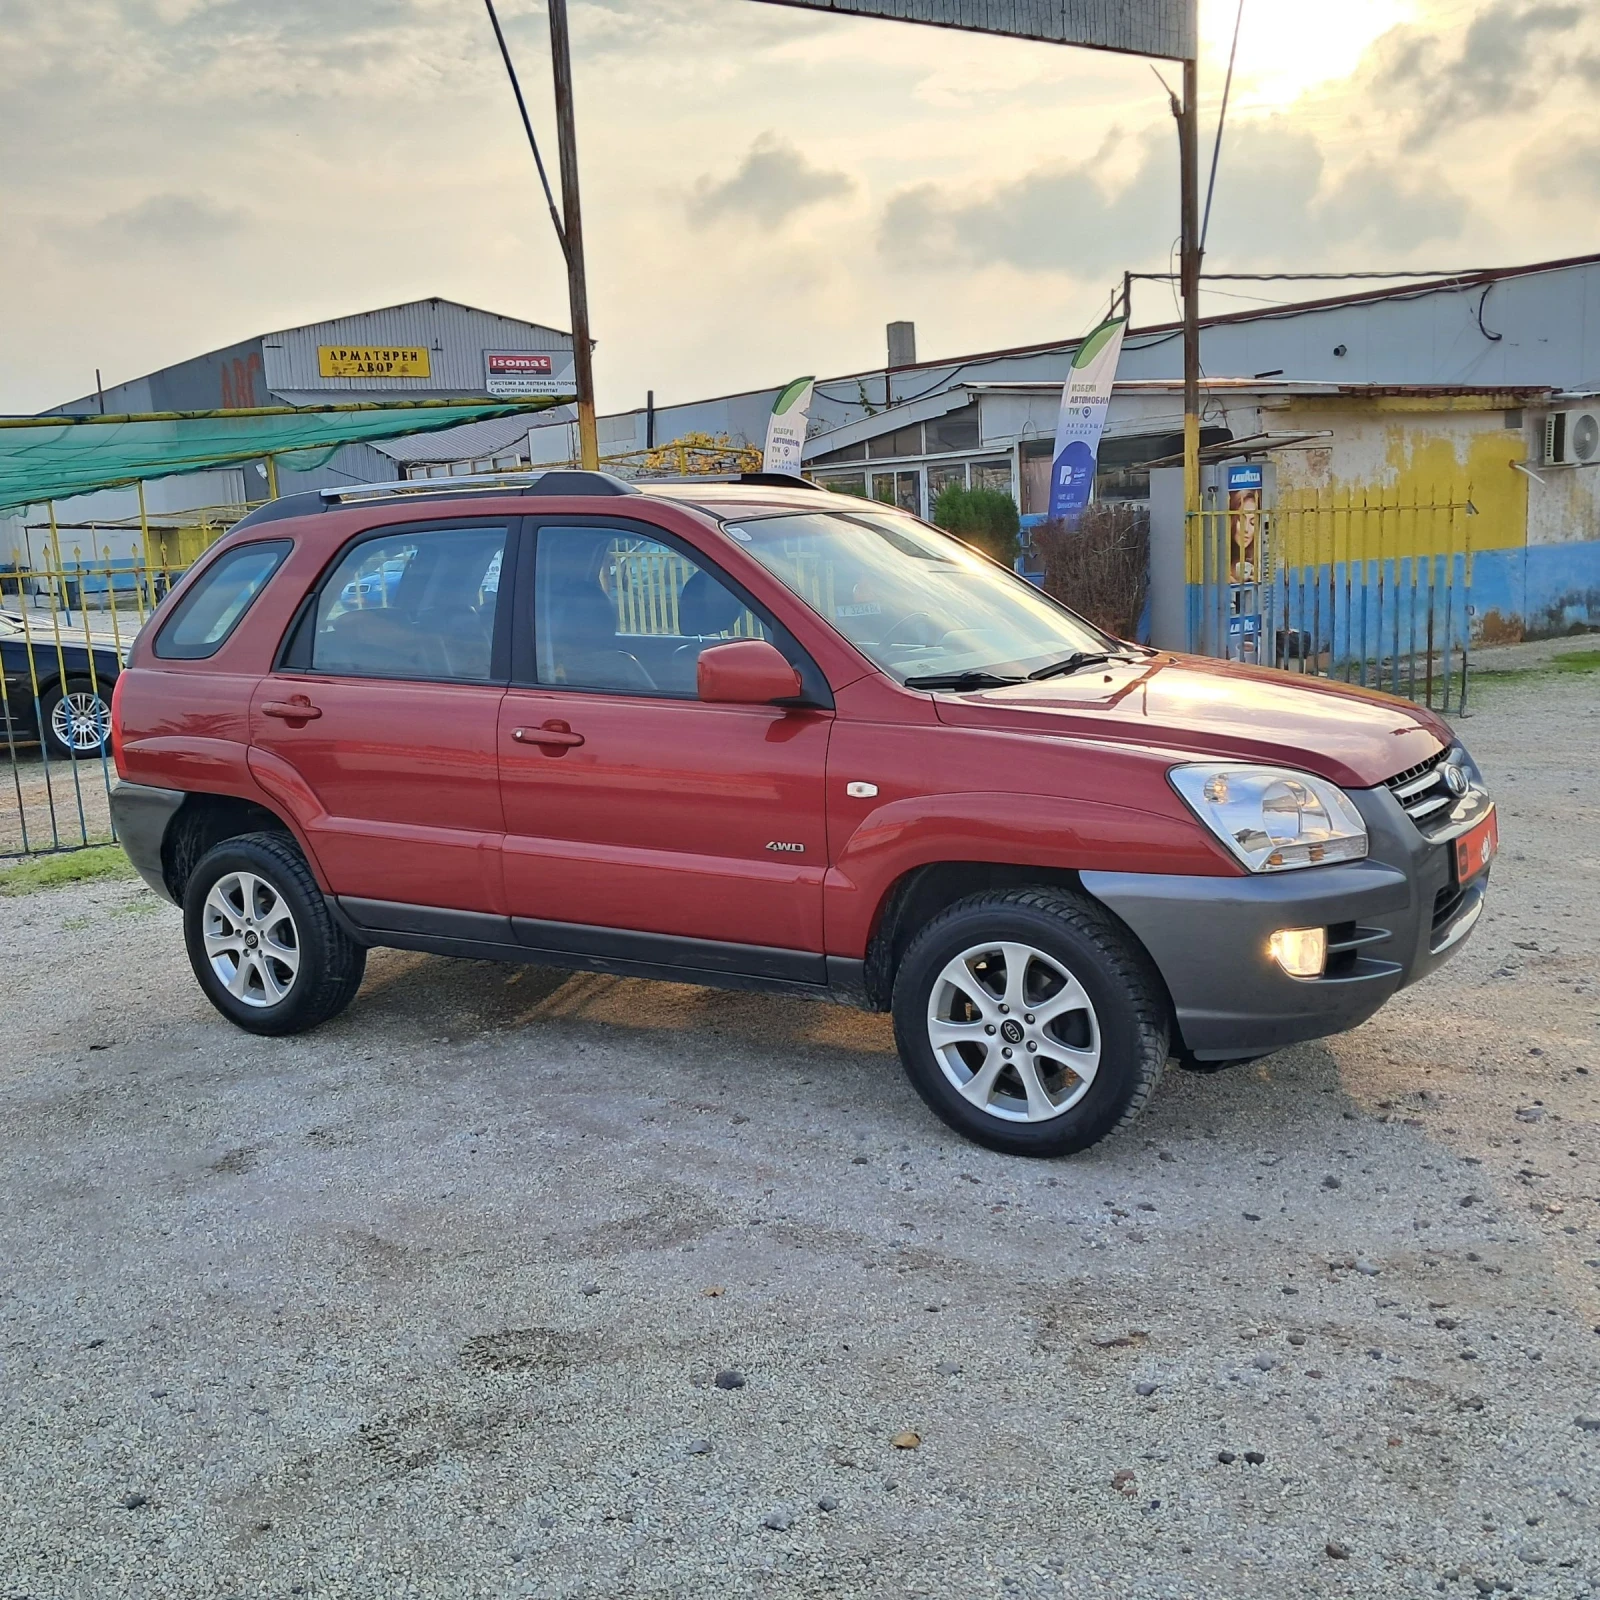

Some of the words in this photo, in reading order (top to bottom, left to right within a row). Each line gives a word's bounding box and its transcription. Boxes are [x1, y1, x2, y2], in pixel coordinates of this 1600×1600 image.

[357, 362, 394, 373] ДВОР
[492, 357, 548, 367] isomat
[765, 841, 805, 852] 4WD
[1005, 1023, 1019, 1041] KIA
